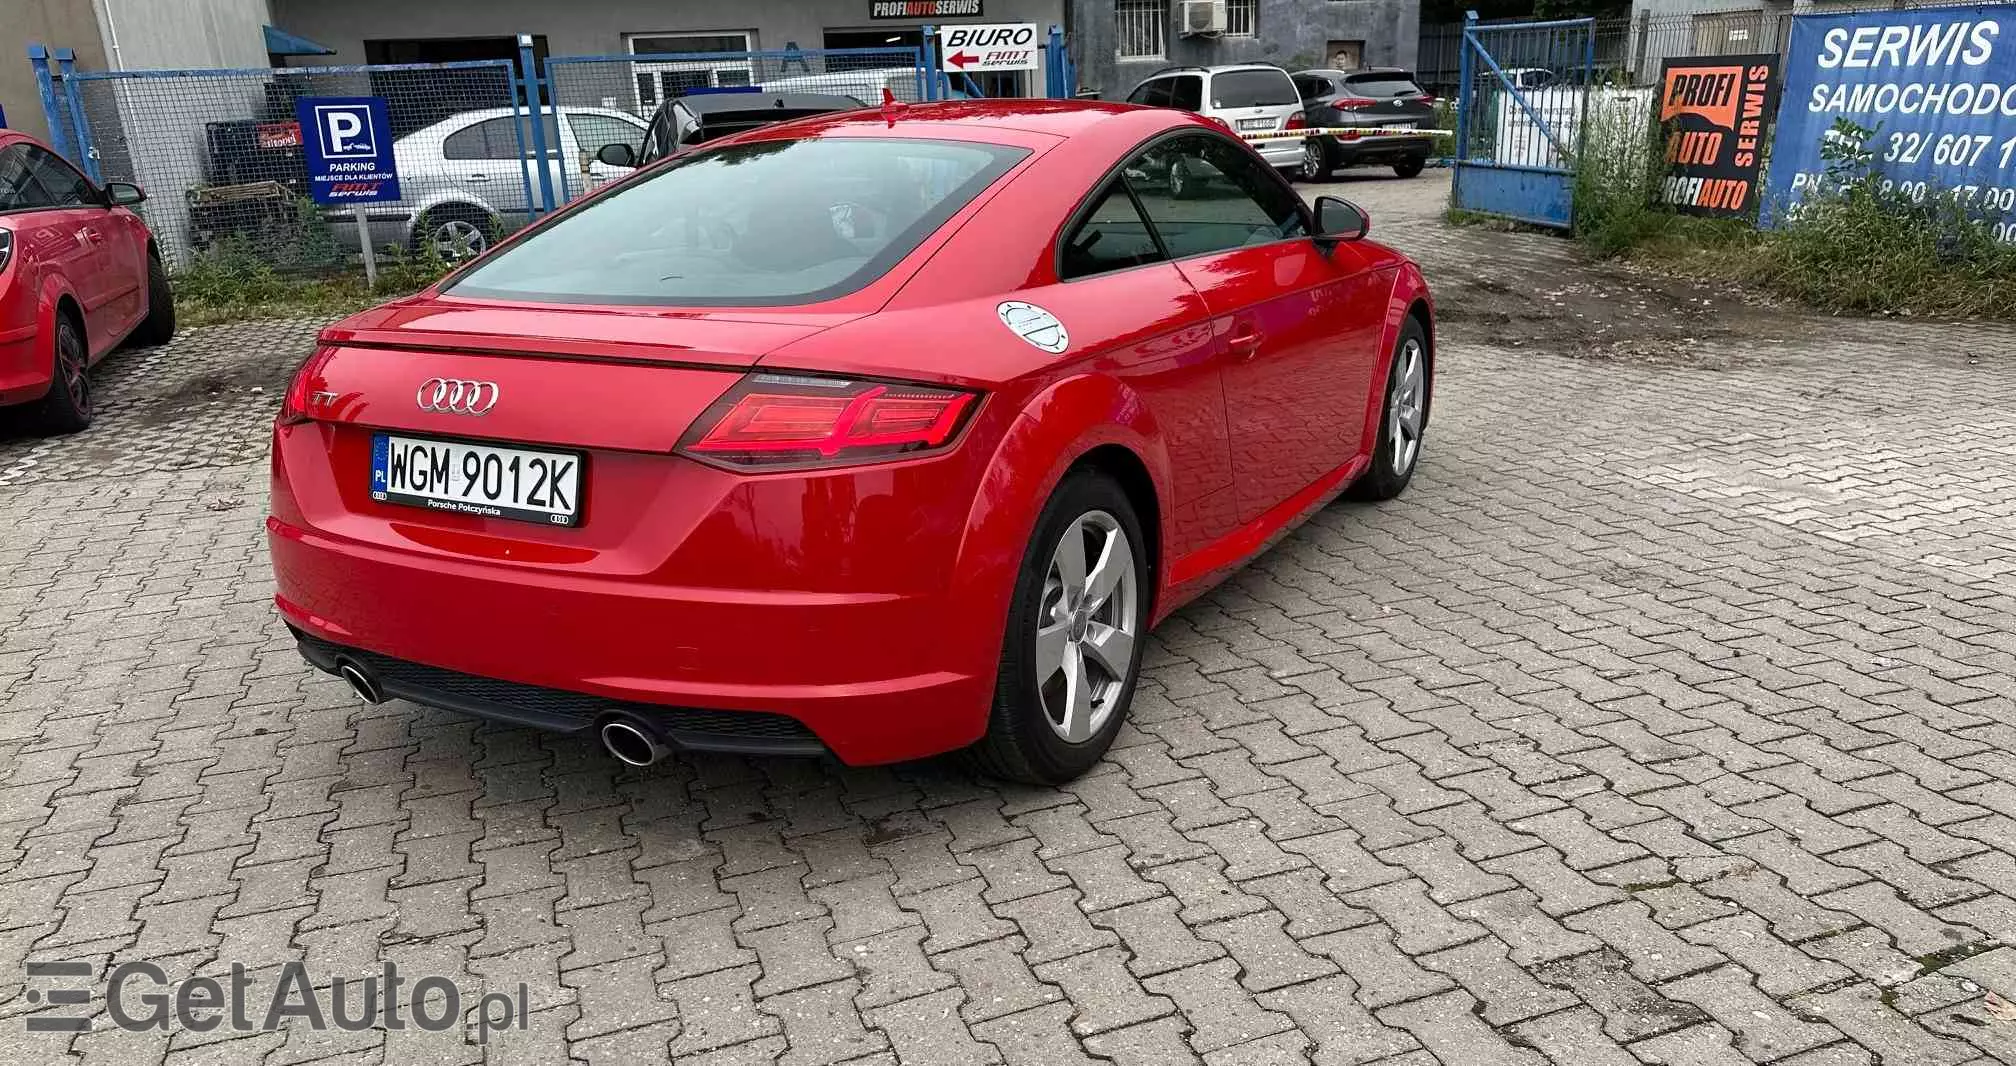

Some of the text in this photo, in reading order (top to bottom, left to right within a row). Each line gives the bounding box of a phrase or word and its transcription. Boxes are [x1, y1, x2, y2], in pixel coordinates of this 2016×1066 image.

[873, 0, 980, 17] PROFIAUTOSERWIS
[946, 28, 1033, 47] BIURO
[1817, 20, 2000, 68] SERWIS
[982, 58, 1029, 66] serwis
[986, 50, 1033, 59] AMT
[1668, 73, 1736, 107] PROFI
[1735, 65, 1769, 167] SERWIS
[327, 112, 361, 152] P
[1664, 131, 1723, 165] AUTO
[329, 162, 376, 172] PARKING
[314, 174, 343, 182] MIEJSCE
[359, 172, 393, 180] KLIENTÓW
[375, 470, 386, 483] PL
[391, 442, 575, 510] WGM 9012K
[427, 499, 457, 510] Porsche
